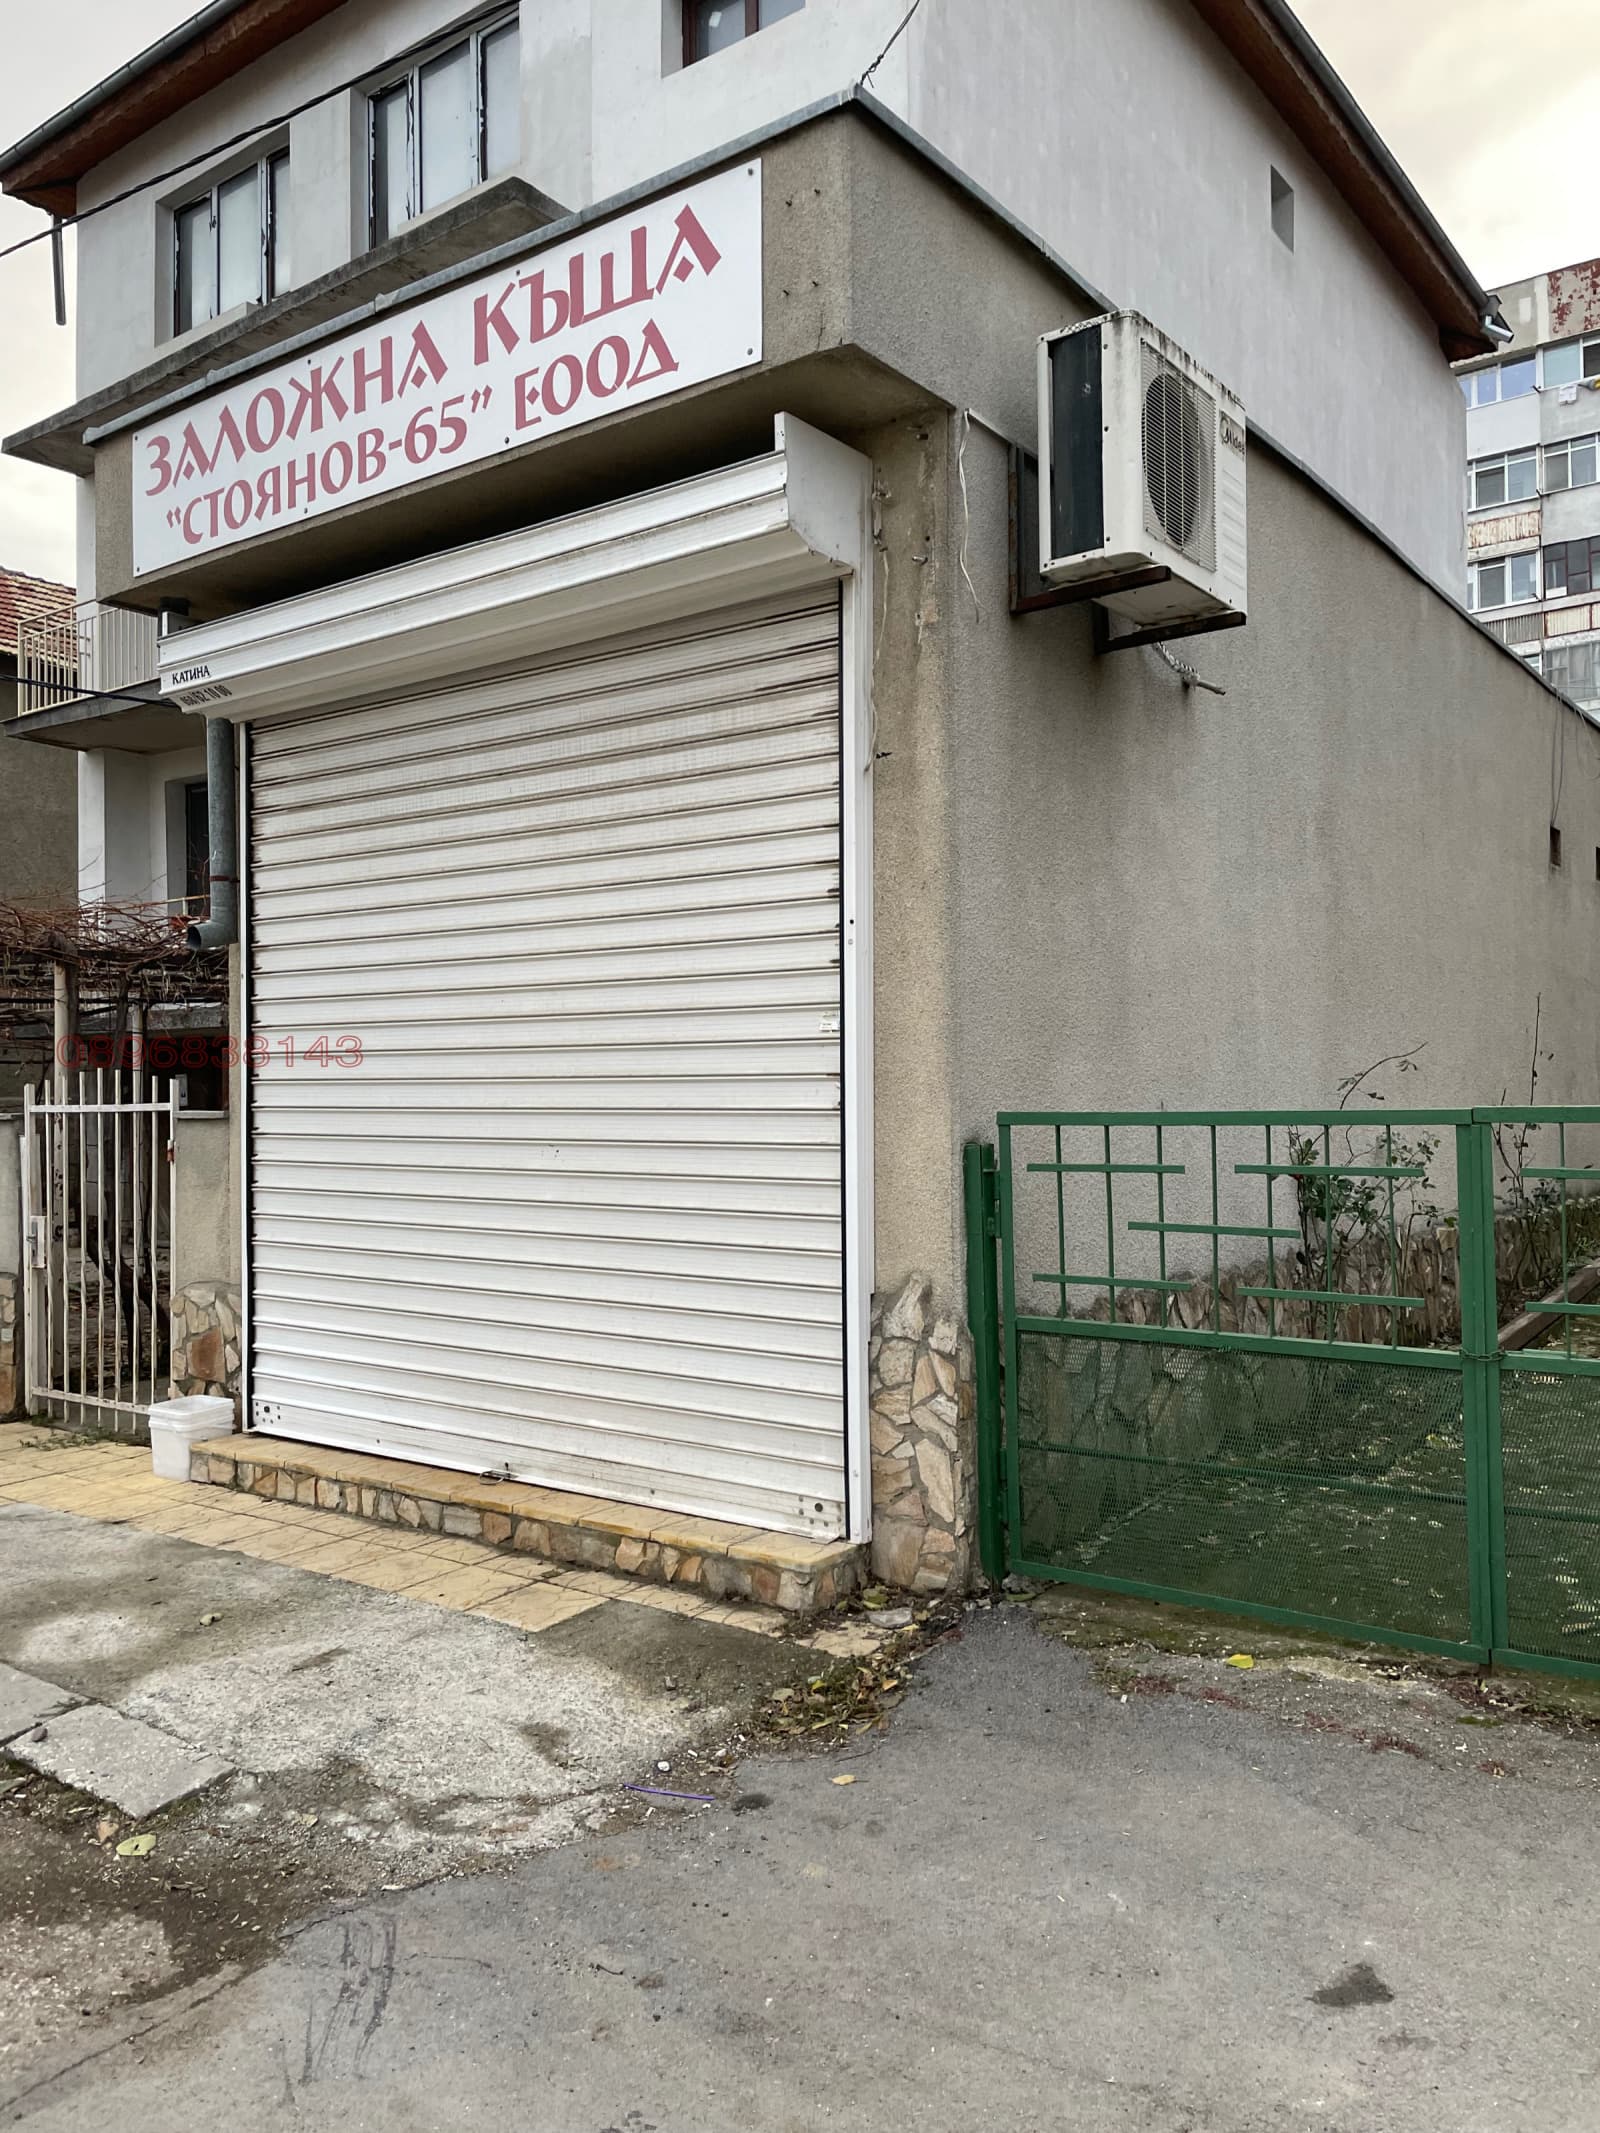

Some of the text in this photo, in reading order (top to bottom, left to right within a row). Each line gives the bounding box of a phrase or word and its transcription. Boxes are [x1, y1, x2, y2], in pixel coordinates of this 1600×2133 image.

[146, 203, 722, 496] ЗАЛОЖНА КЪЩА
[514, 318, 680, 431] ЕООД
[172, 665, 210, 685] КАТИНА
